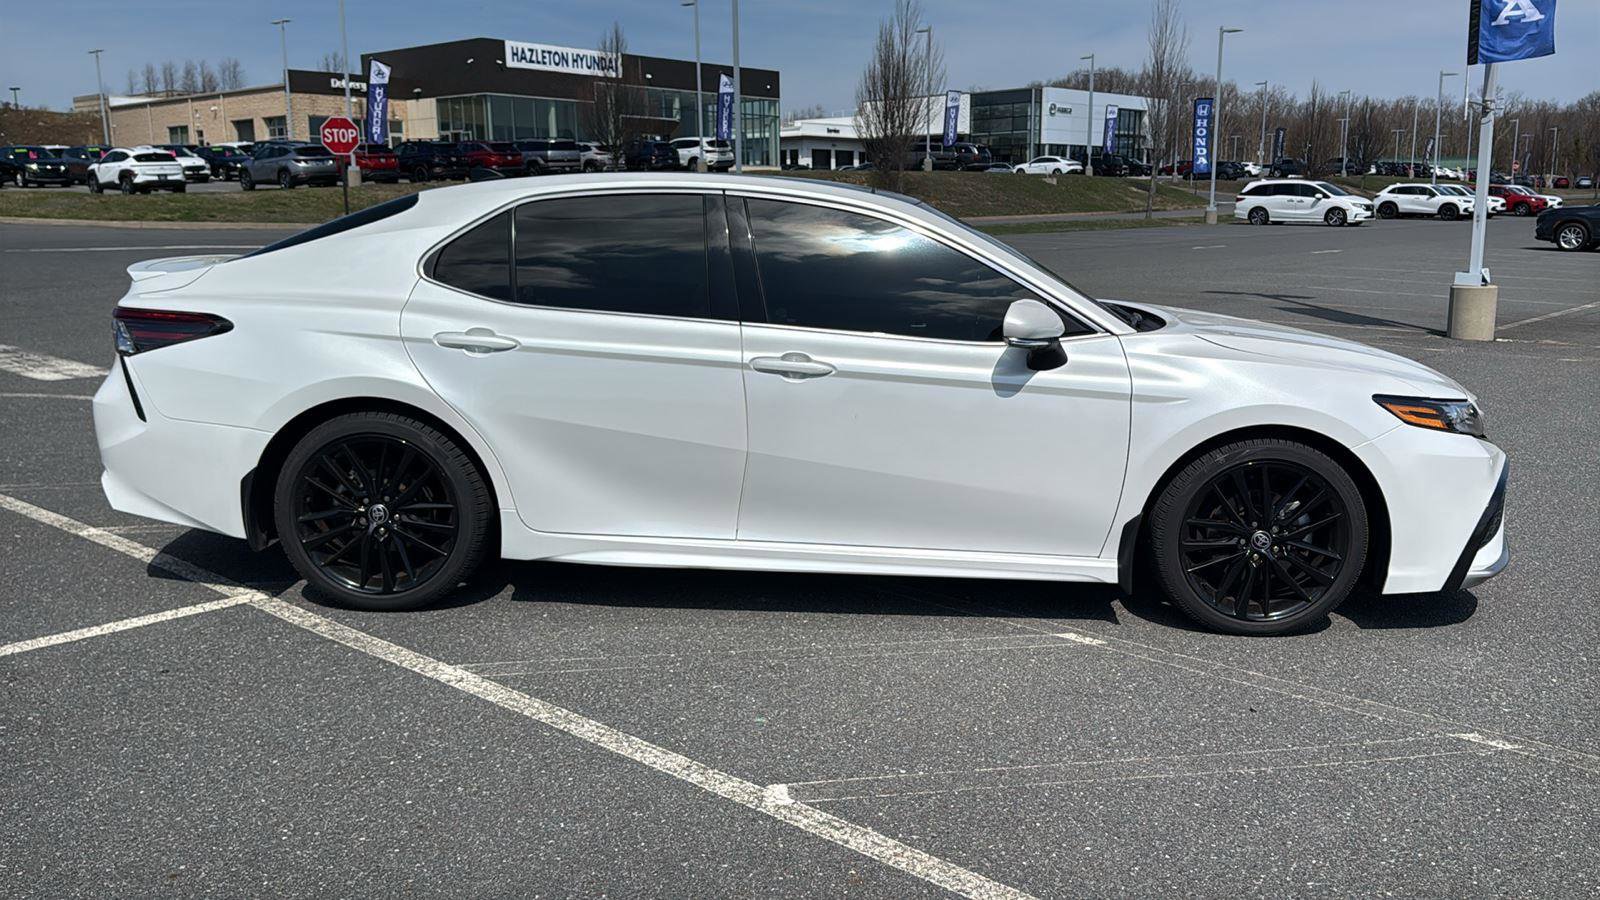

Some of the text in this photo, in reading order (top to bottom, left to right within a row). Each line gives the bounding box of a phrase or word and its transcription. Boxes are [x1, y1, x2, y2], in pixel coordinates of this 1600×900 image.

[511, 46, 619, 73] HAZLETON HYUNDAI
[372, 86, 384, 142] HYUNDAI
[323, 128, 357, 143] STOP
[1195, 119, 1208, 165] HONDA
